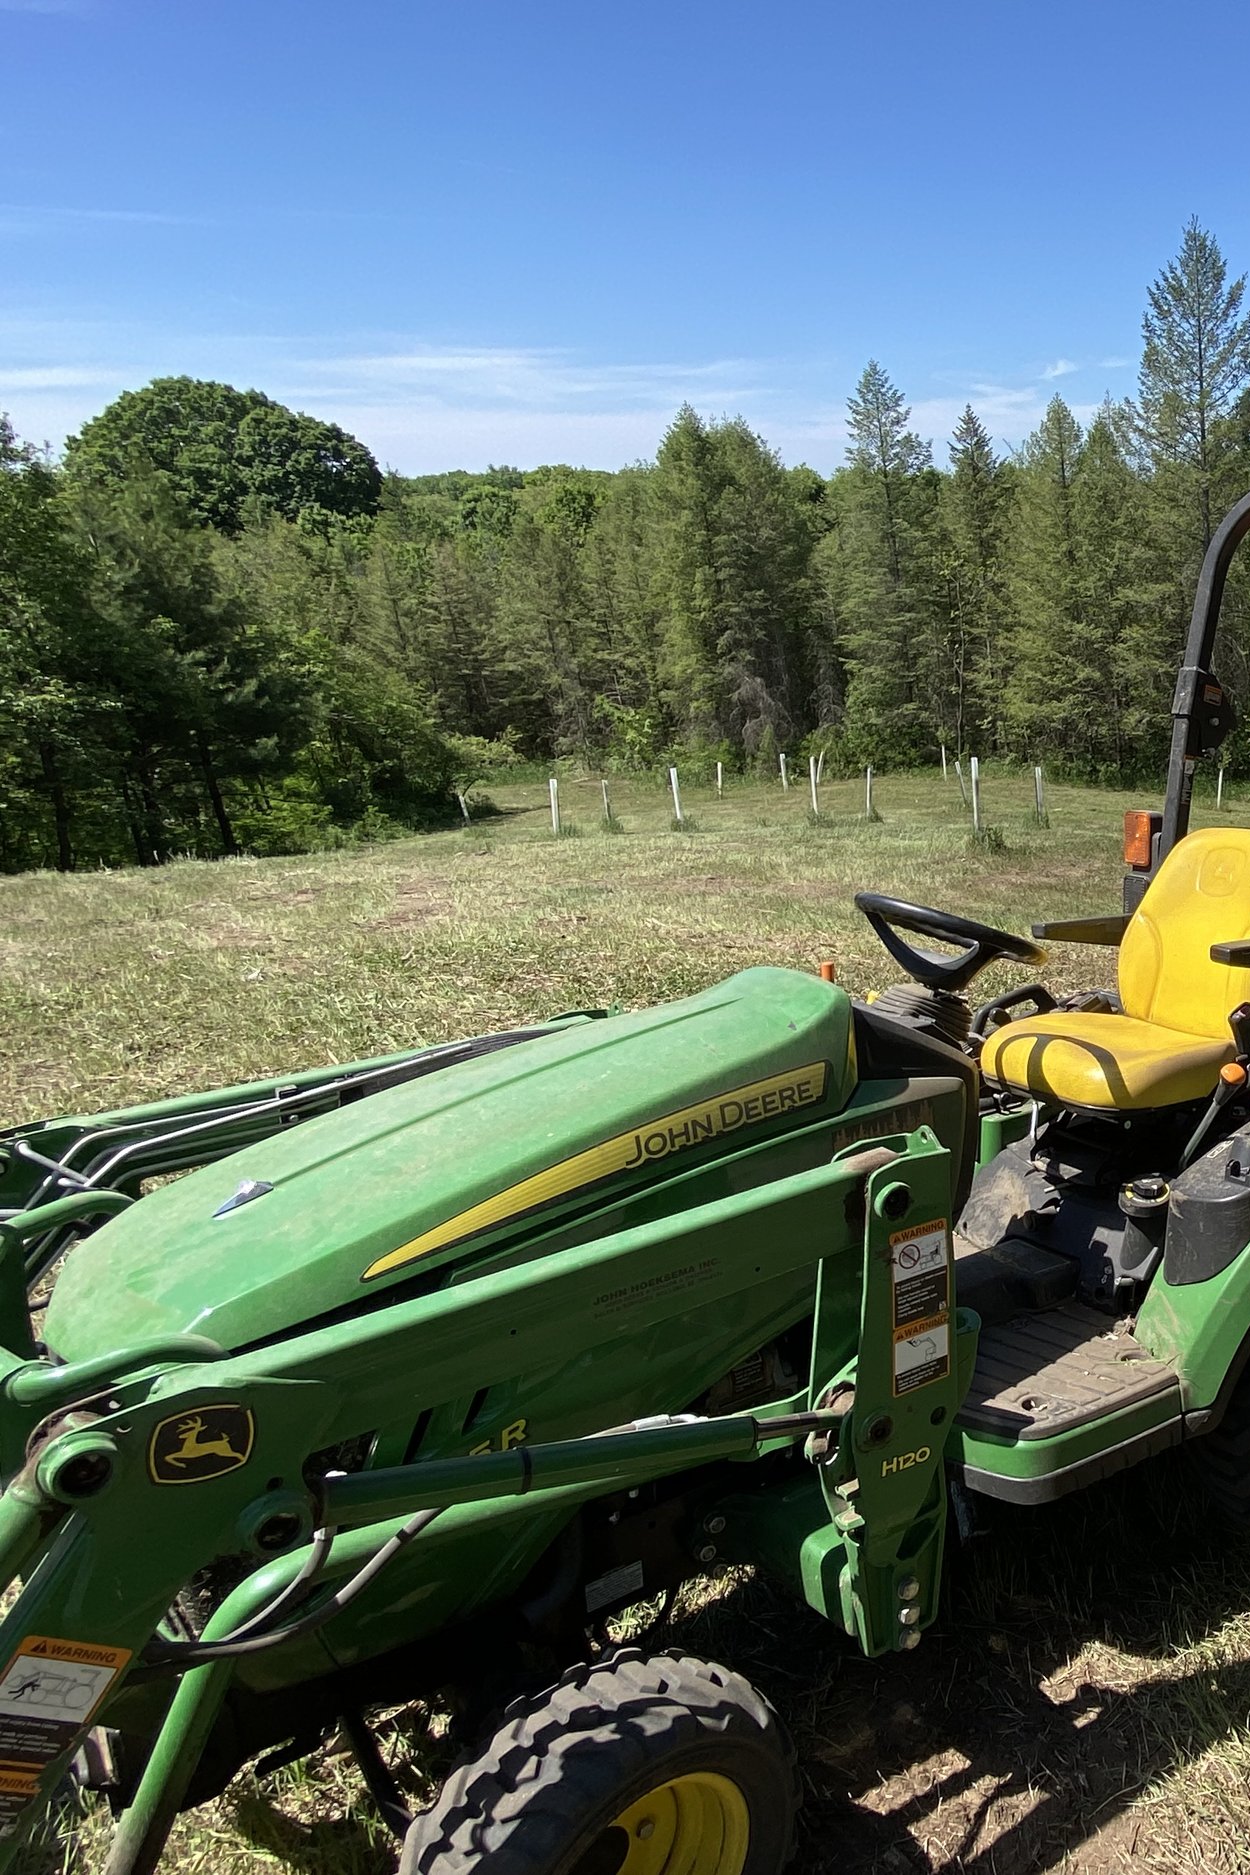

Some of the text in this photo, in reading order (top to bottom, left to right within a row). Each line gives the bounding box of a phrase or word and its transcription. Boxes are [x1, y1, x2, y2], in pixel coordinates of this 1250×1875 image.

[625, 1081, 813, 1166] JOHN DEERE
[901, 1220, 945, 1241] WARNING
[593, 1287, 627, 1306] JOHN
[631, 1266, 695, 1293] HOEKSEMA
[904, 1316, 946, 1337] WARNING
[881, 1446, 931, 1477] H120
[51, 1644, 118, 1663] WARNING
